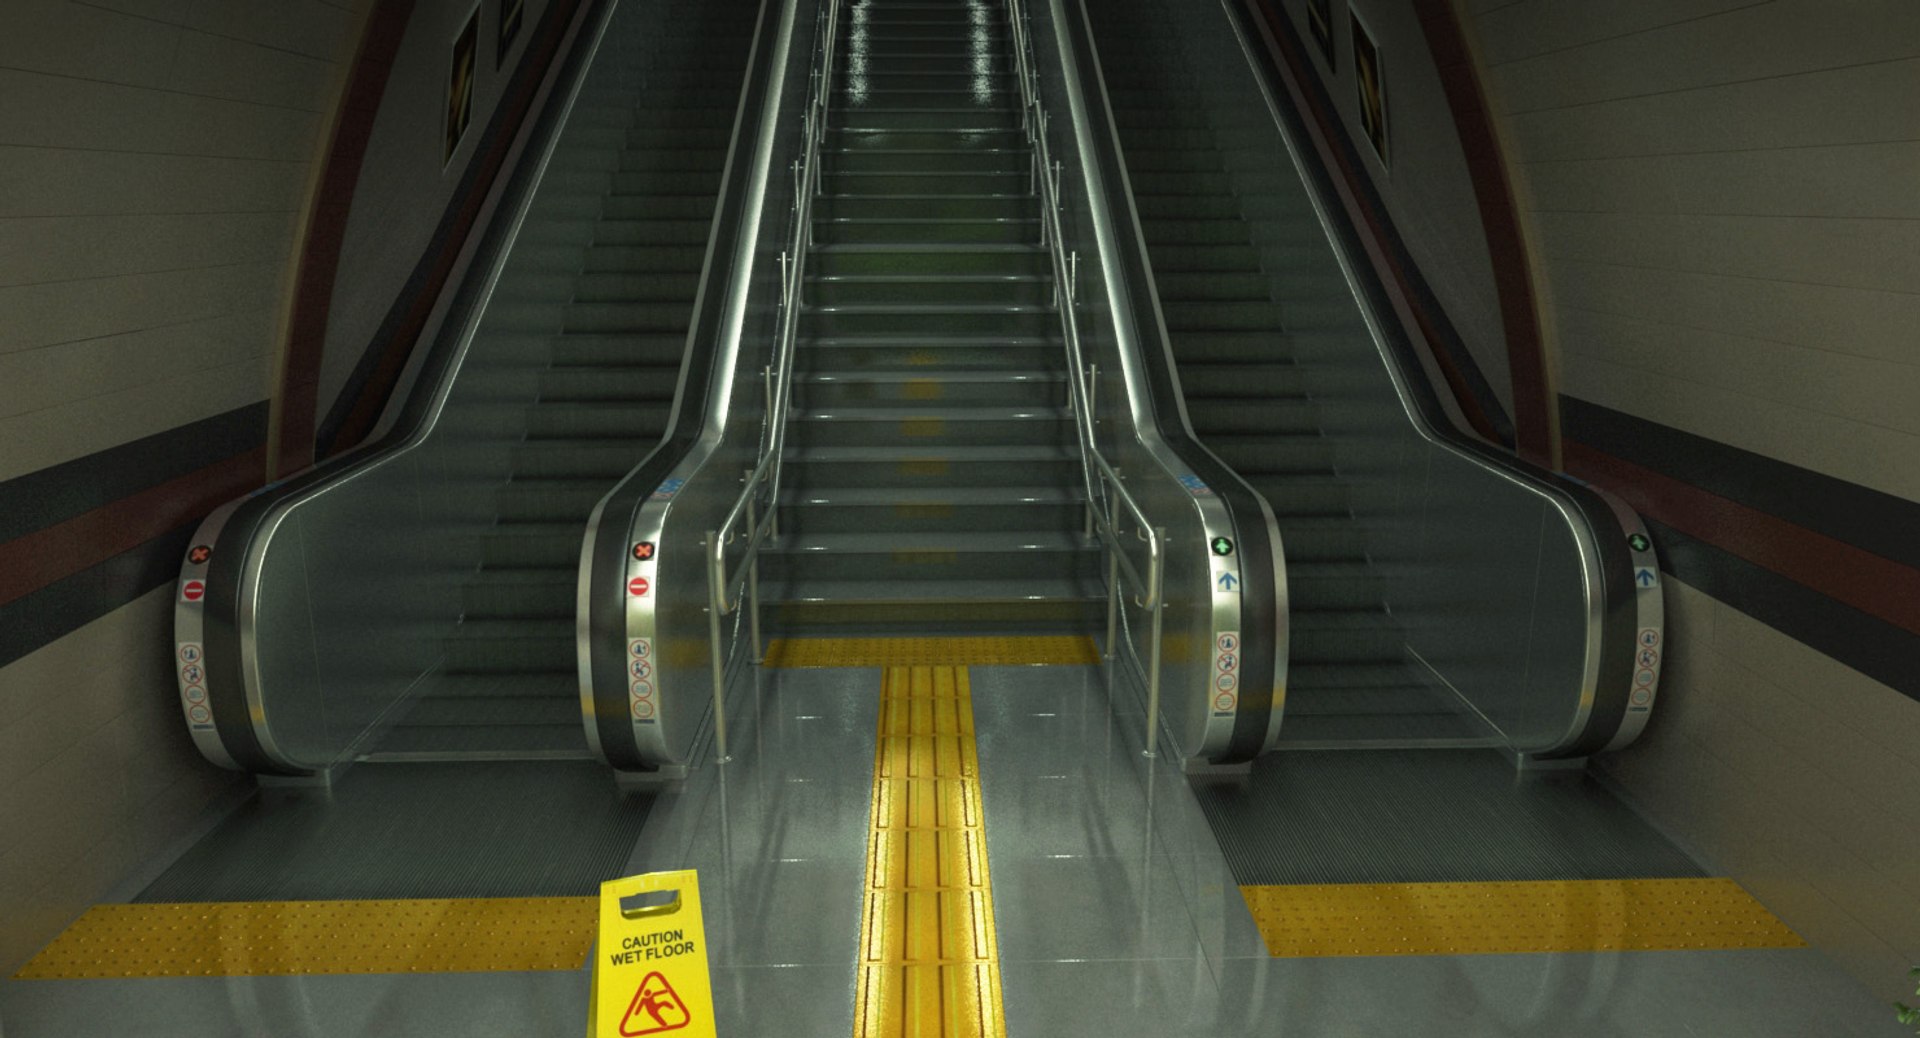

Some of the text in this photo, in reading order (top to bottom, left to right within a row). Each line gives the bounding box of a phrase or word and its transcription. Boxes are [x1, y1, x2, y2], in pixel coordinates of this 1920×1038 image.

[622, 929, 683, 950] CAUTION
[610, 941, 694, 966] WET FLOOR
